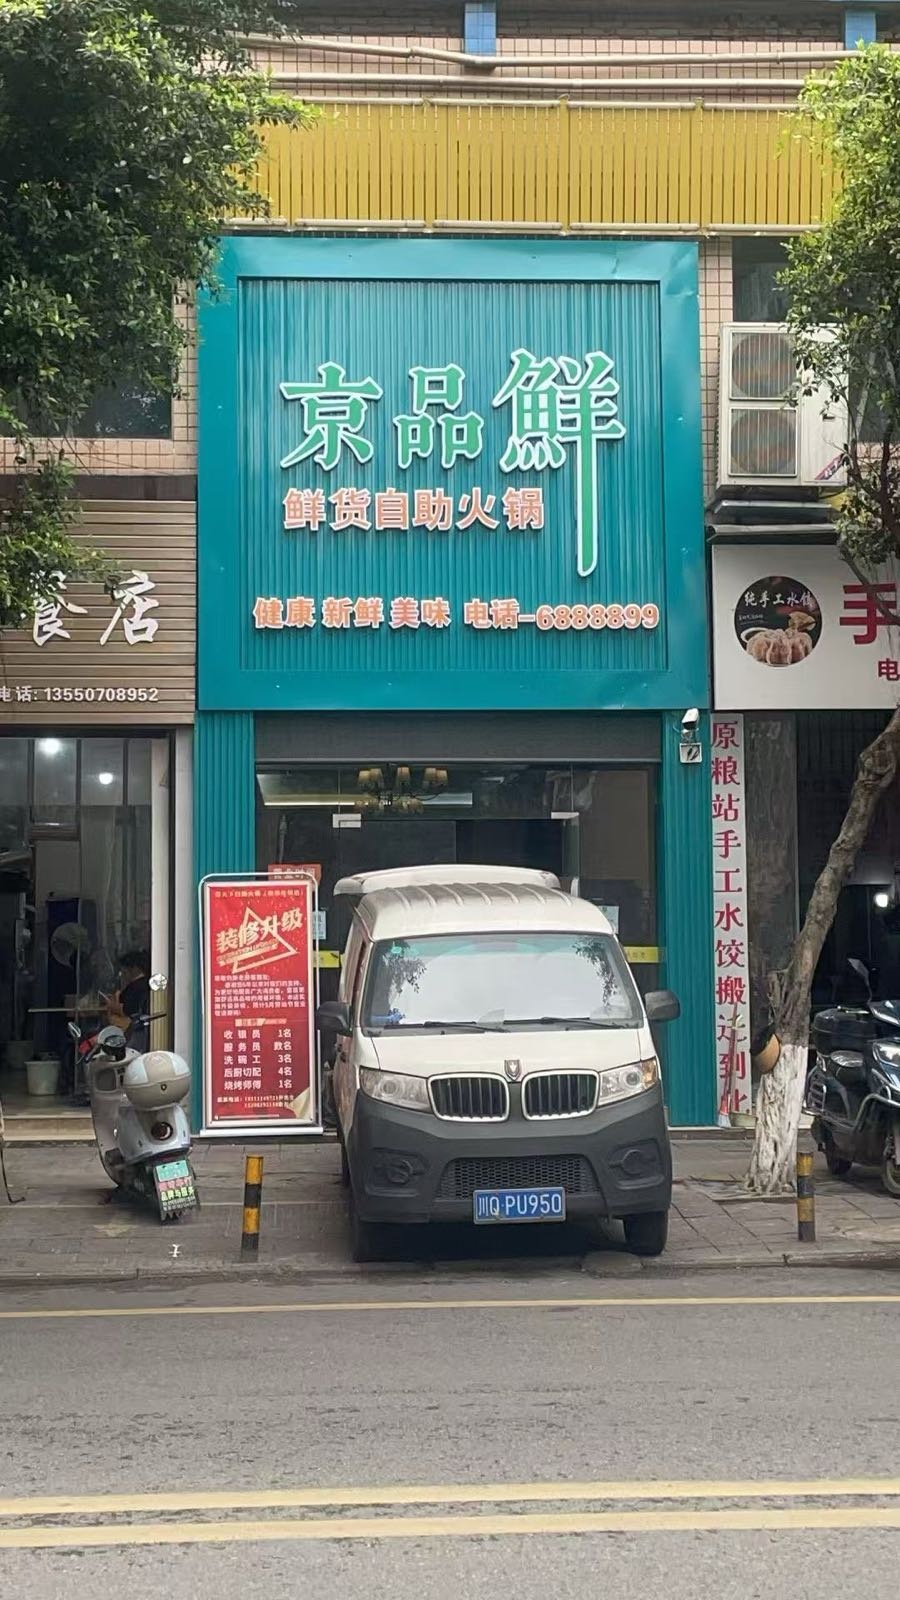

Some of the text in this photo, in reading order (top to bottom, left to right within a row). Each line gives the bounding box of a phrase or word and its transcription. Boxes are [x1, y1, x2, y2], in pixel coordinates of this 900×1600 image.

[283, 487, 544, 531] 鲜货自助火锅
[253, 597, 316, 629] 健康
[322, 597, 384, 628] 新鲜
[390, 597, 451, 628] 美味
[44, 687, 159, 701] 13550708952
[216, 907, 303, 953] 装修升级
[278, 1028, 292, 1038] 1名
[278, 1054, 292, 1063] 3名
[278, 1066, 292, 1076] 4名
[279, 1079, 292, 1089] 1名
